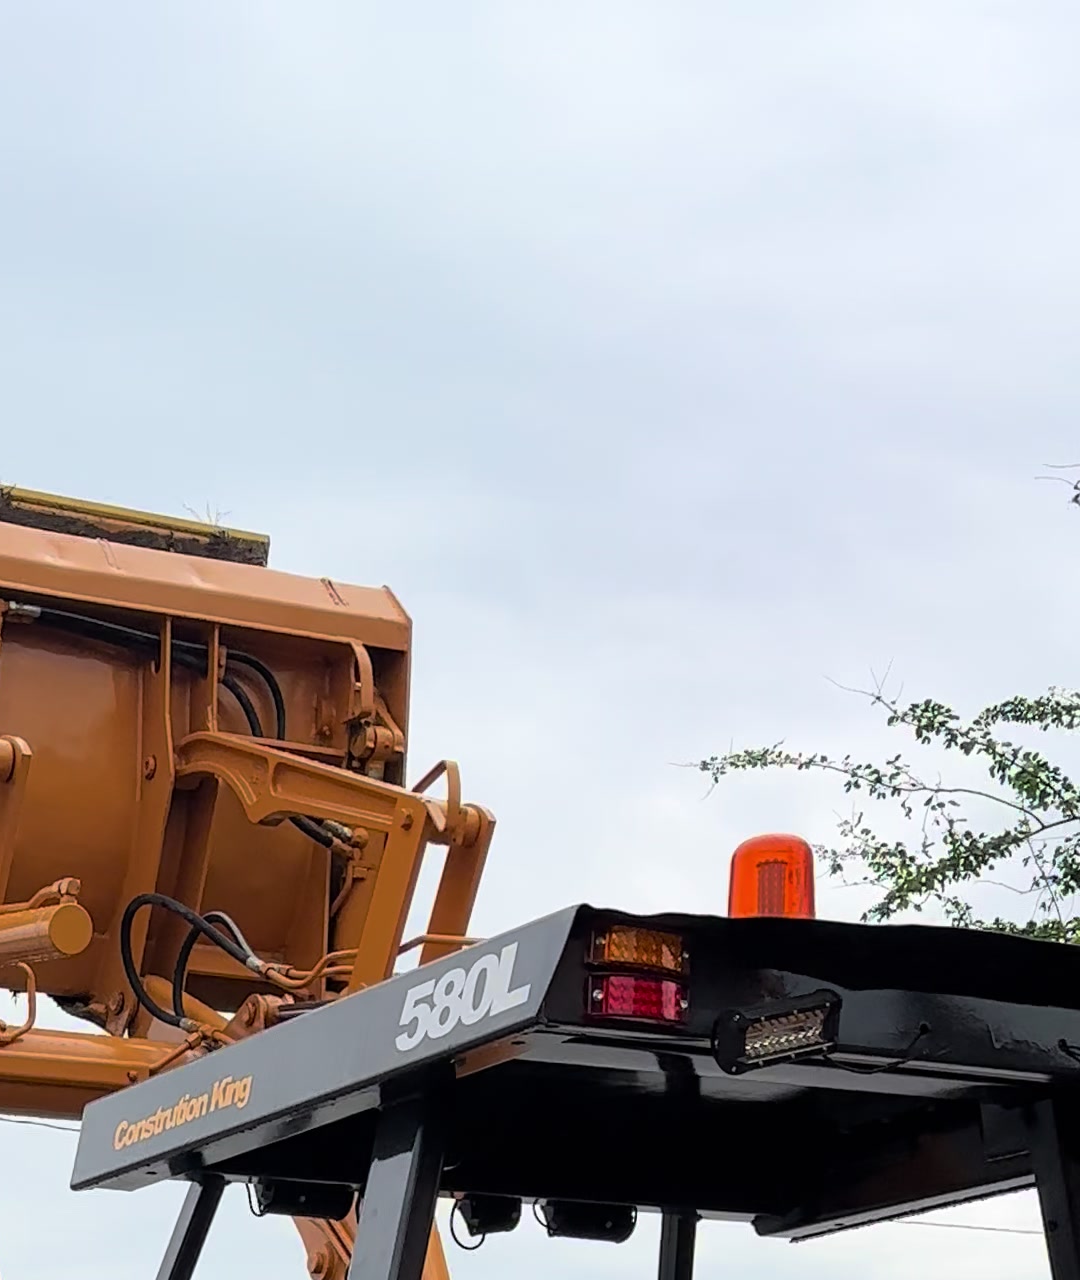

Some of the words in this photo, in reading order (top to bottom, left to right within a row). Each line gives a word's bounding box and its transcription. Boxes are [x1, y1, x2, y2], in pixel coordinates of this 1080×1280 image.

[395, 942, 531, 1051] 580L
[114, 1094, 208, 1150] Constrution
[210, 1075, 253, 1110] King
